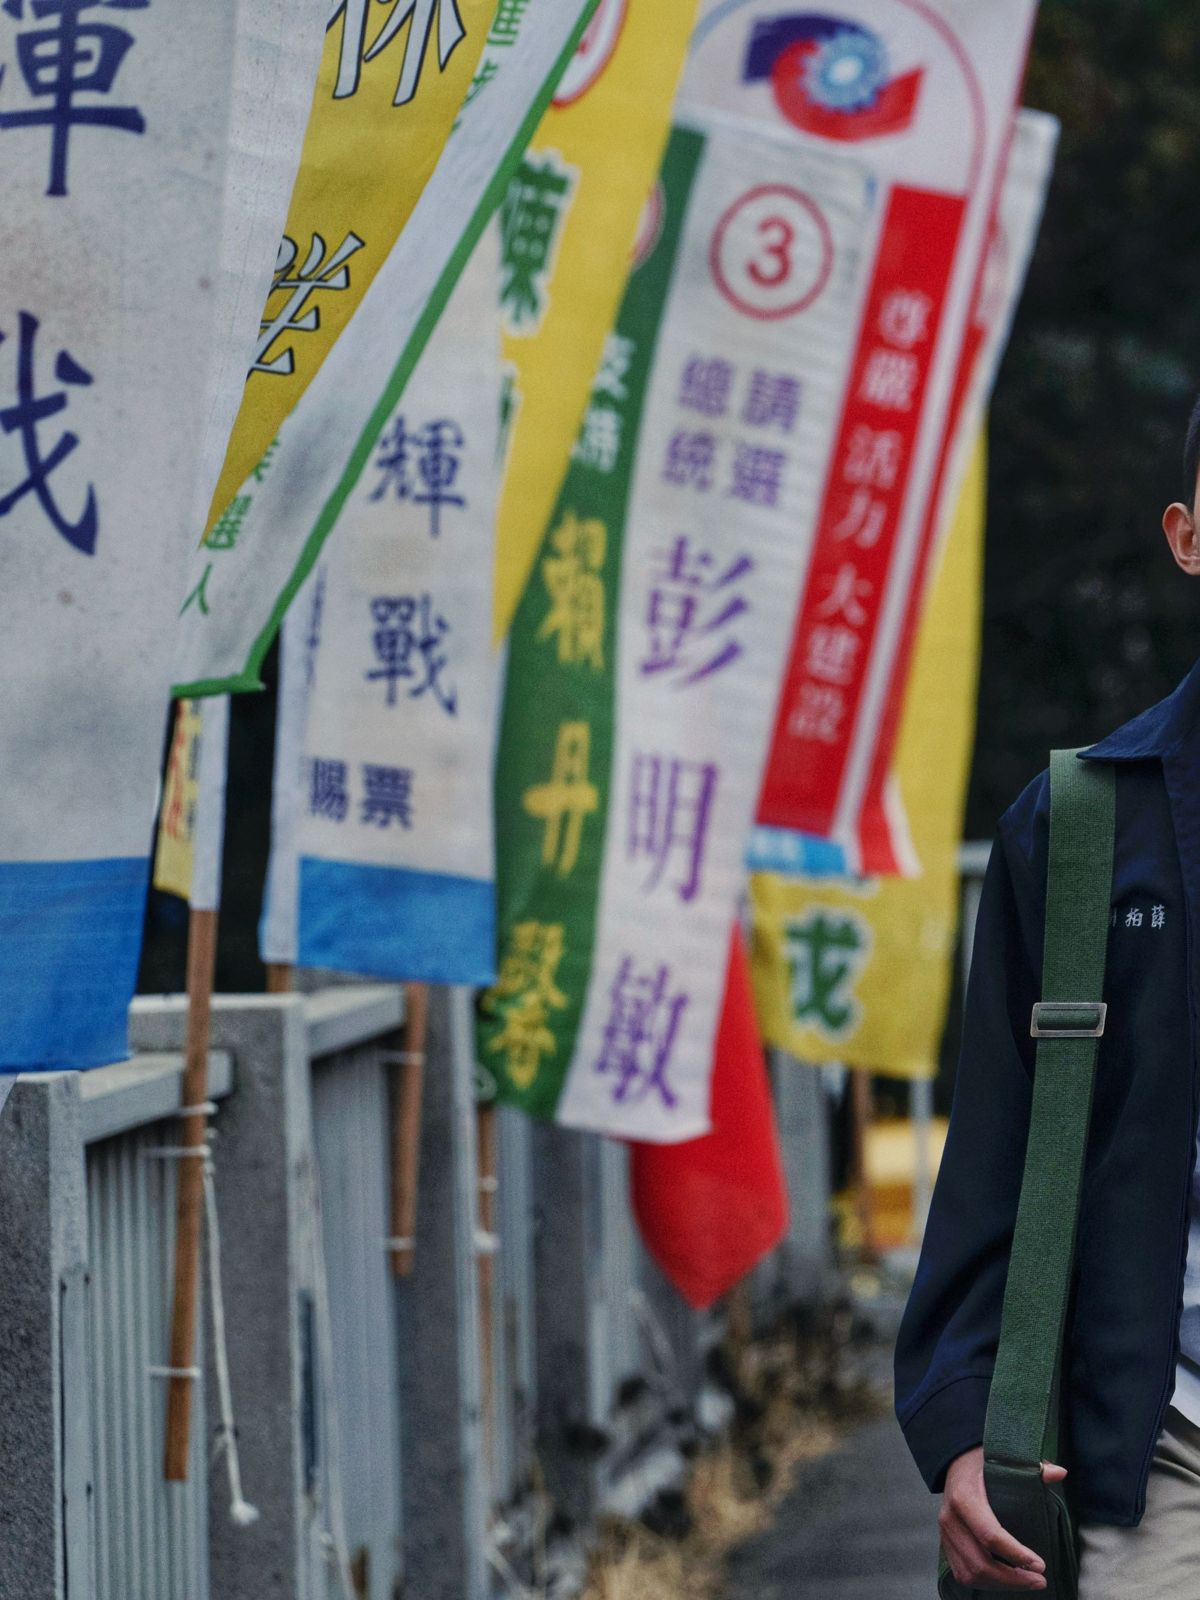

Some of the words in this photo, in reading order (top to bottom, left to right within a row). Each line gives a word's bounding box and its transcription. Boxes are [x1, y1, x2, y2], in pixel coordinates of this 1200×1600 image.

[745, 215, 794, 287] 3
[595, 534, 754, 1109] 彭明敏
